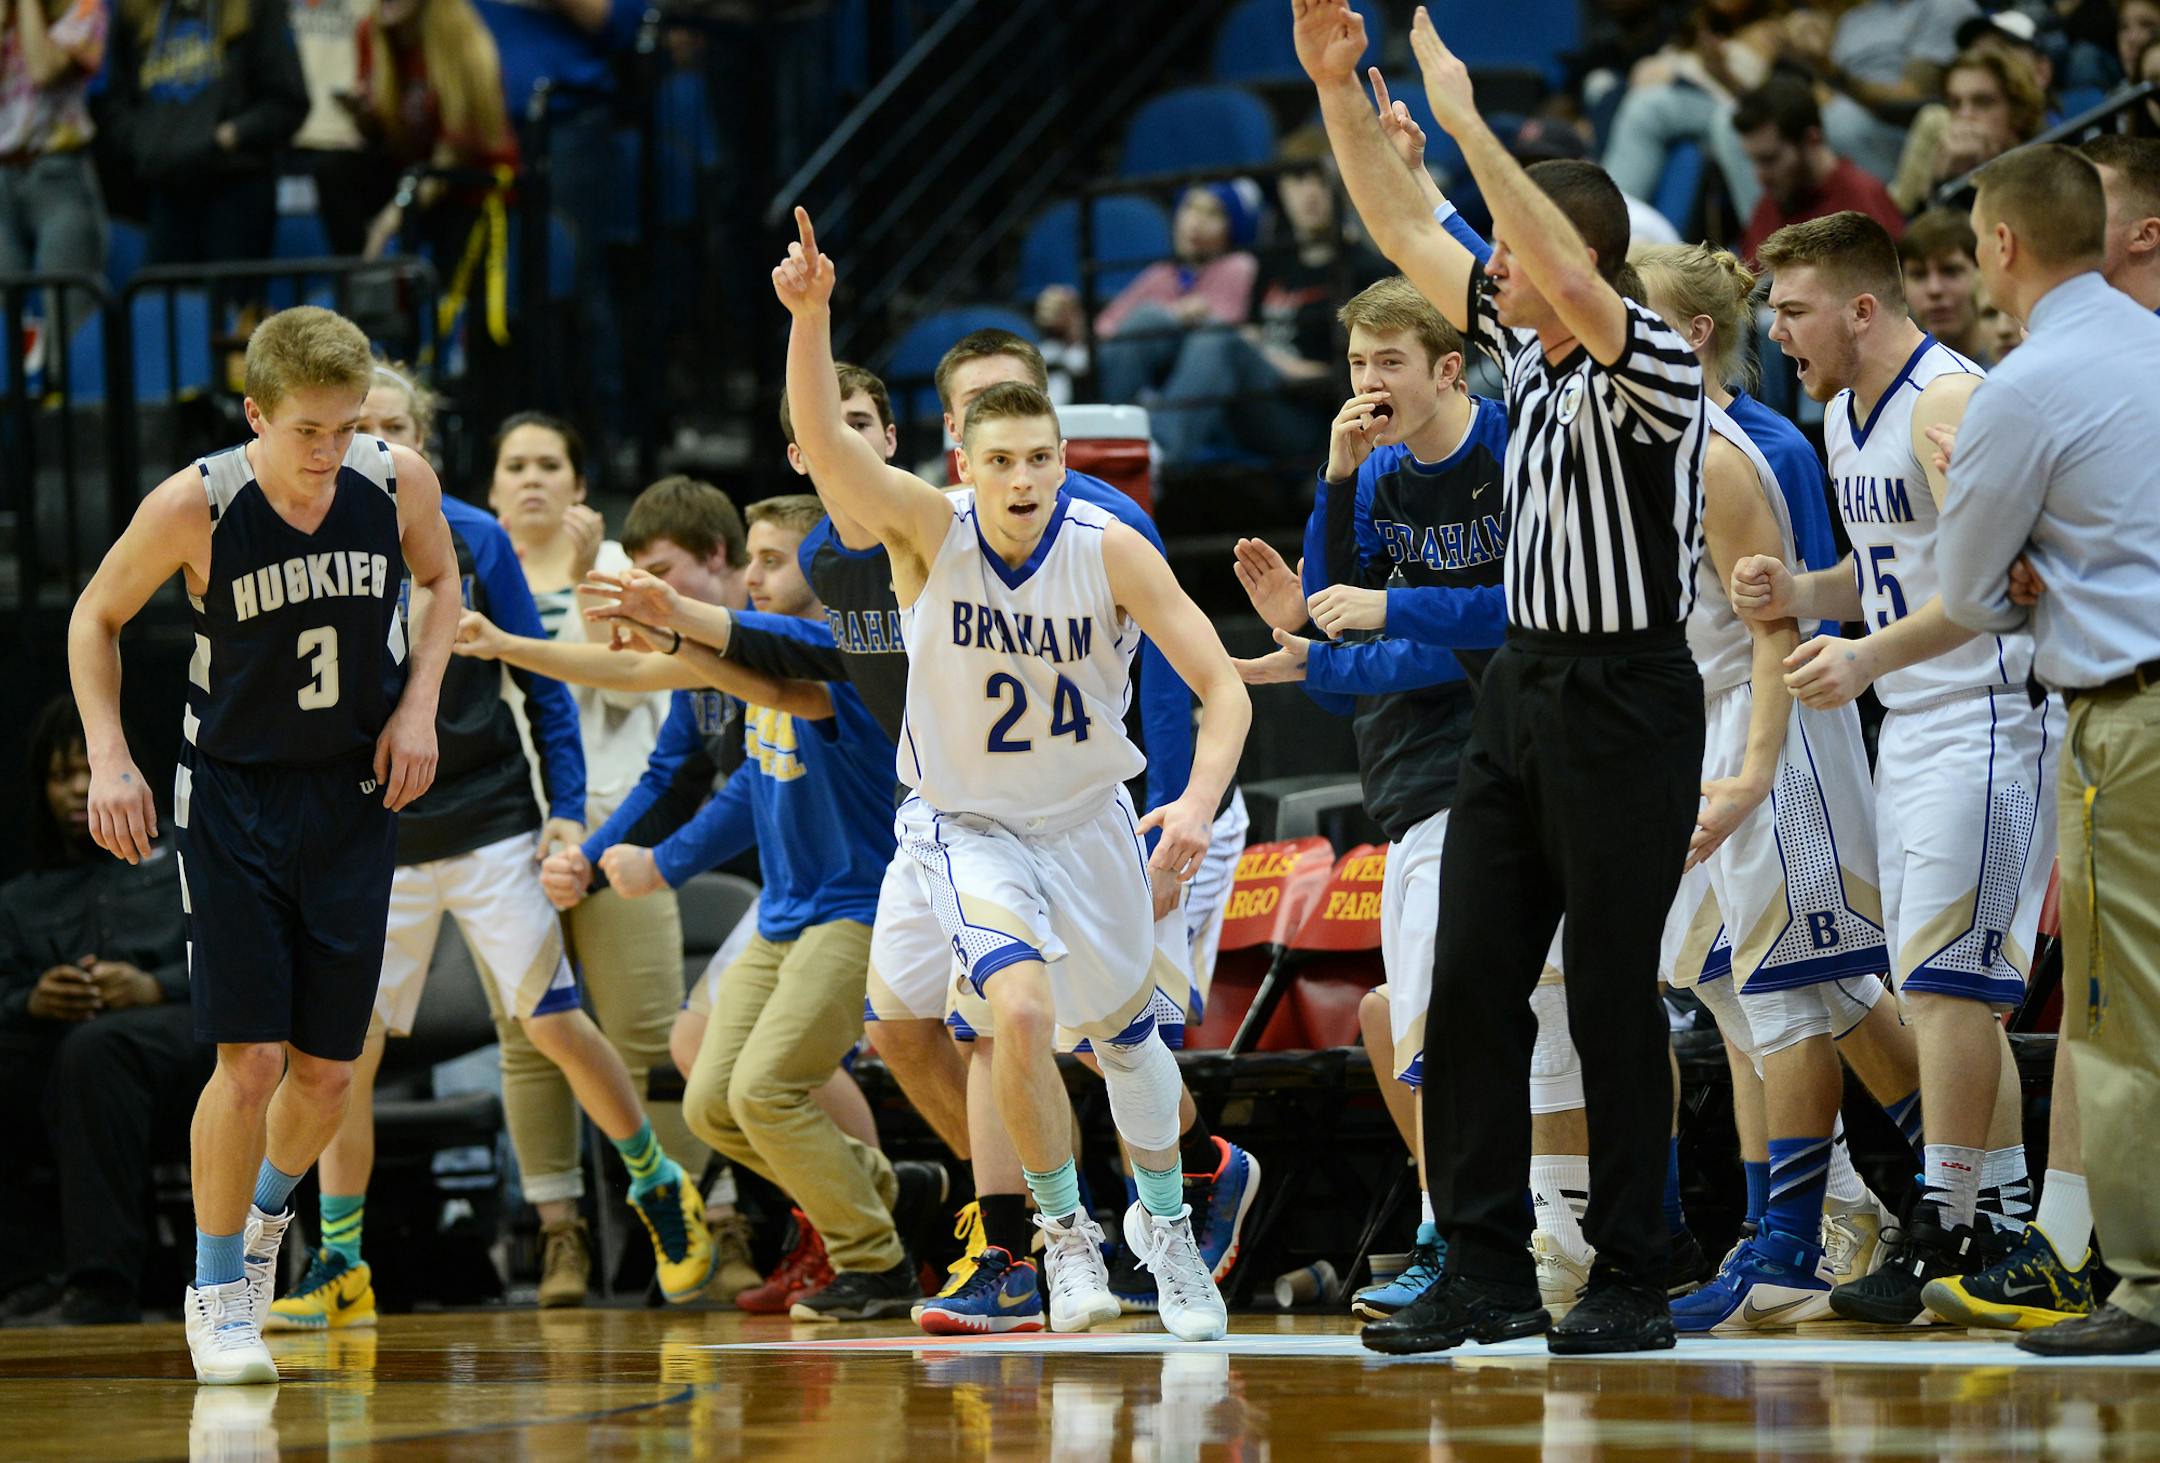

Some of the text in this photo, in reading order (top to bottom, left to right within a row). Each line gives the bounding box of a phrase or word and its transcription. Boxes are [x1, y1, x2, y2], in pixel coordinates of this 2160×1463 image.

[231, 551, 388, 622] HUSKIES
[952, 600, 1093, 664] BRAHAM
[297, 625, 340, 711] 3
[984, 671, 1095, 754] 24
[1234, 852, 1302, 881] ELLS
[1804, 910, 1840, 950] B
[1981, 928, 2002, 968] B
